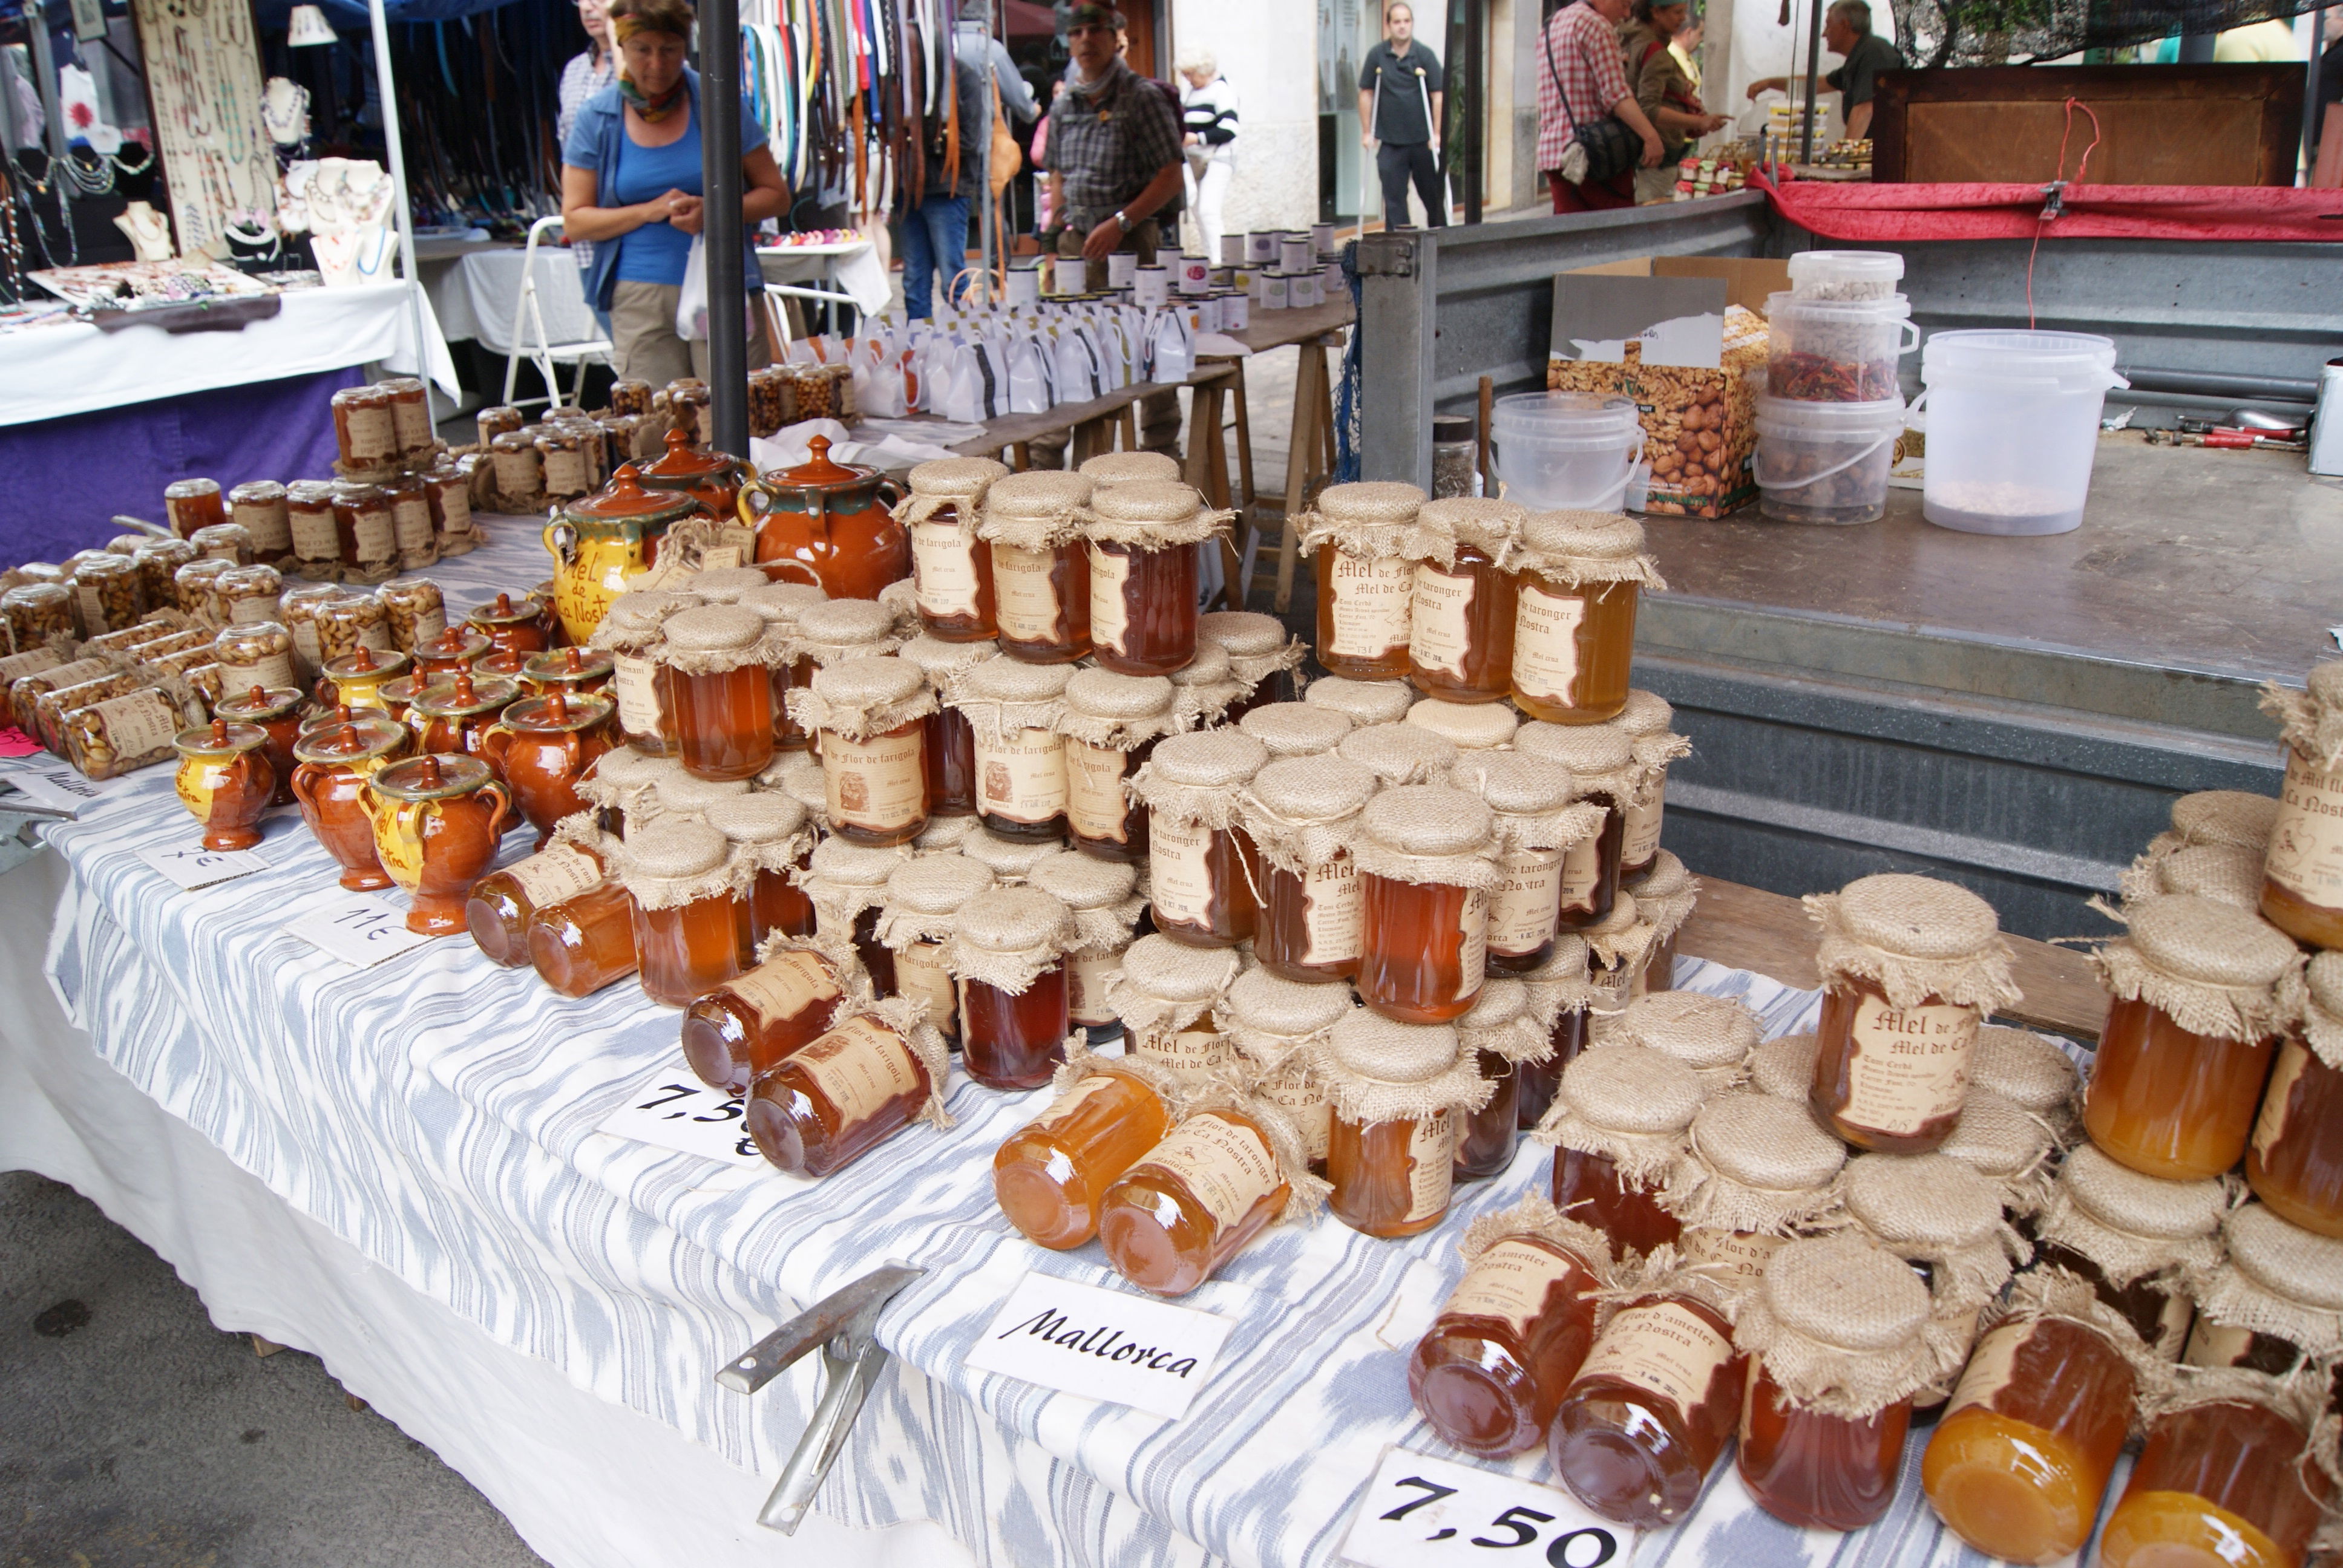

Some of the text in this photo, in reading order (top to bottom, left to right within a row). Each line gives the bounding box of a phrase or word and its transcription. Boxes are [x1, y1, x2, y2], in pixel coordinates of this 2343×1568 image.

[1657, 494, 1707, 506] WALNUTS
[927, 538, 961, 549] farigola
[1006, 561, 1041, 573] farigola
[1337, 561, 1414, 578] Mel de Flor
[572, 582, 585, 598] de
[1355, 582, 1412, 594] Mel de Ca
[1424, 580, 1462, 598] taronger
[557, 595, 608, 623] Ca Nost
[1415, 592, 1441, 610] Nostra
[1530, 603, 1571, 621] taronger
[1519, 615, 1549, 634] Nostra
[140, 710, 157, 736] Nostra
[156, 714, 171, 733] Mel
[831, 750, 837, 760] de
[841, 754, 863, 763] Flor
[881, 749, 914, 762] farigola
[988, 742, 1007, 753] Flor
[1024, 742, 1061, 754] farigola
[180, 759, 191, 776] el
[2301, 771, 2324, 789] Mil
[2286, 789, 2298, 805] Ca
[1160, 831, 1200, 847] taronger
[555, 848, 582, 866] Flor de
[1152, 840, 1181, 860] Nostra
[1316, 863, 1354, 883] Mel
[1521, 857, 1561, 874] taronger
[557, 861, 583, 890] Nostra
[1337, 880, 1360, 897] Mel
[905, 953, 940, 969] farigola
[790, 961, 819, 988] farigola
[1599, 971, 1625, 987] Mel
[1873, 1010, 1950, 1034] Mel de
[1142, 1035, 1178, 1053] Mel
[1201, 1040, 1225, 1054] Flor
[1889, 1040, 1924, 1054] Mel
[1931, 1042, 1946, 1054] de
[842, 1026, 900, 1084] Flor de farigola
[1161, 1055, 1221, 1069] Mel de Ca
[857, 1063, 876, 1089] Mel crua
[1272, 1080, 1300, 1090] Flor
[1278, 1096, 1295, 1105] Ca
[1420, 1115, 1450, 1142] Mel
[1194, 1130, 1210, 1139] Ca
[1212, 1138, 1252, 1175] Nostra
[1196, 1121, 1271, 1185] Flor de taronger
[1153, 1157, 1193, 1177] Mallorca
[1219, 1173, 1240, 1201] Mel crua
[1698, 1227, 1709, 1240] de
[1695, 1241, 1706, 1256] de
[1634, 1323, 1691, 1347] Nostra
[1653, 1312, 1715, 1347] d'ametler
[997, 1308, 1197, 1378] Mallorca
[1656, 1352, 1692, 1376] Mel crua
[1379, 1477, 1617, 1568] 7,50
